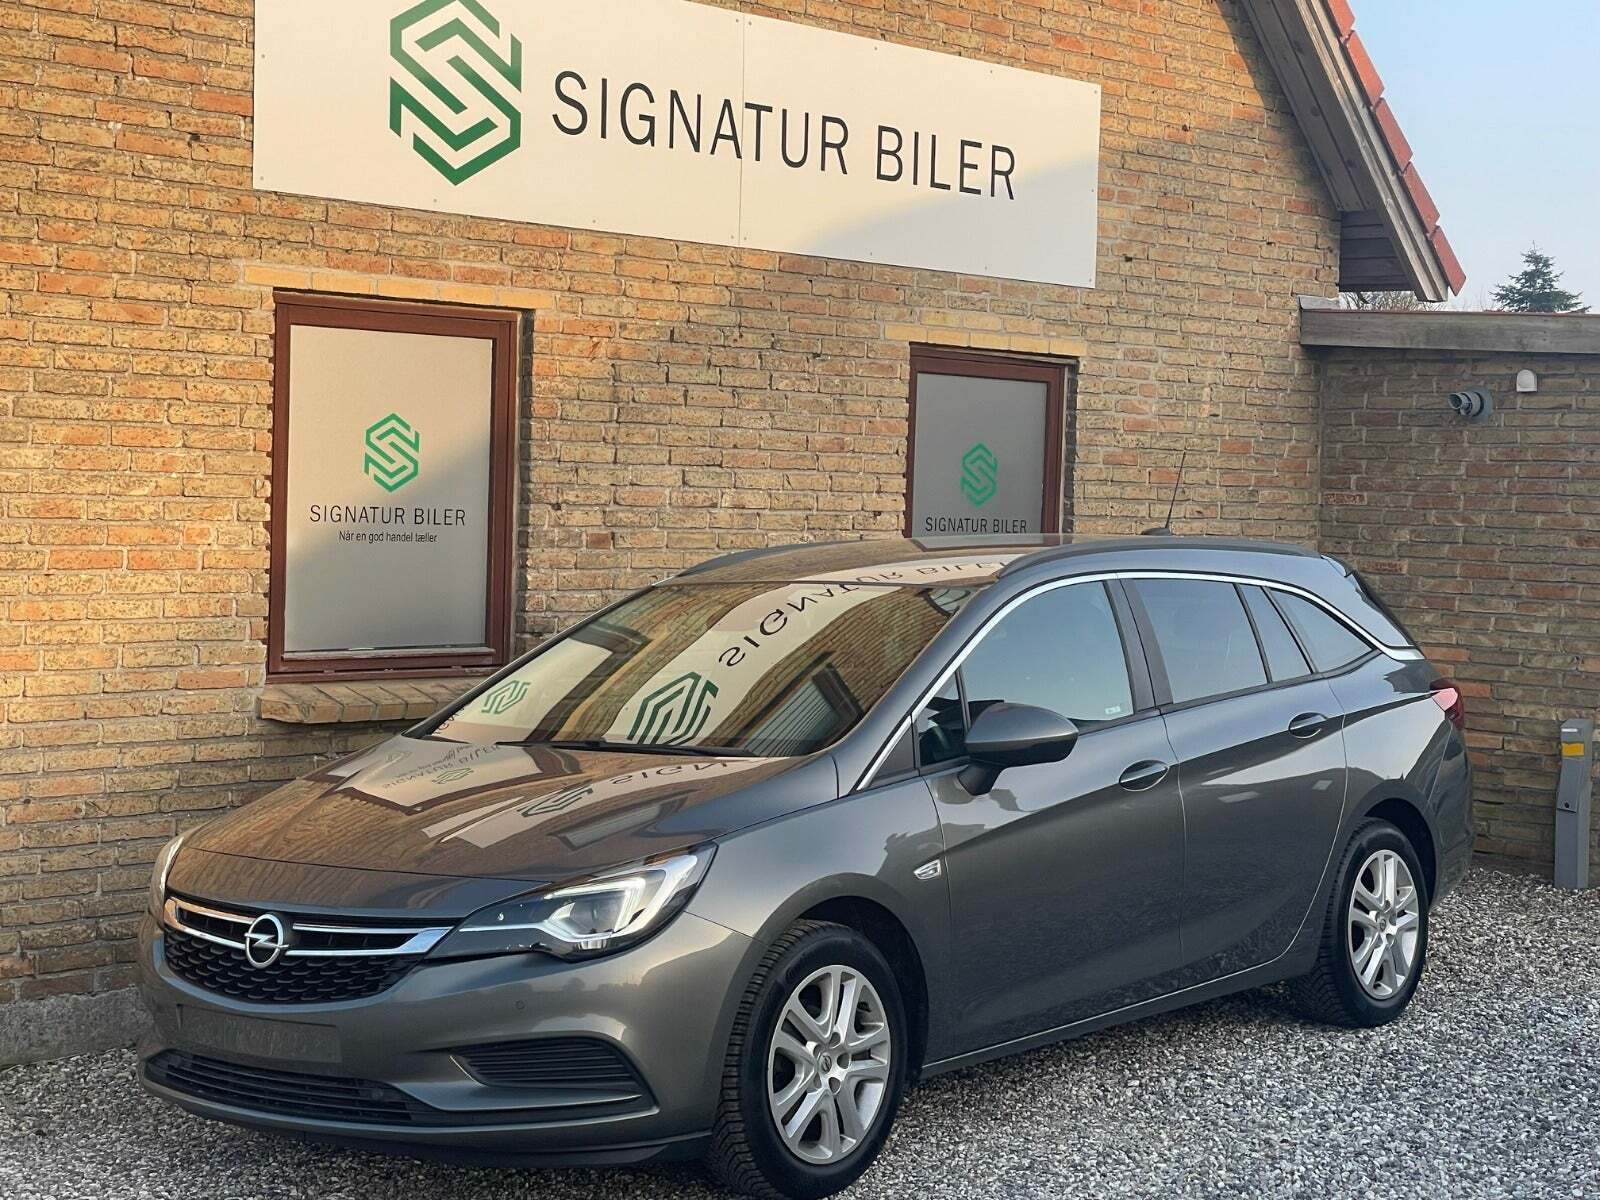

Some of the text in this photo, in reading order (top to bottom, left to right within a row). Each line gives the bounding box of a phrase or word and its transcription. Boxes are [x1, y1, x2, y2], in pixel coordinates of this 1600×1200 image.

[552, 69, 1017, 200] SIGNATUR BILER
[310, 505, 466, 526] SIGNATUR BILER
[925, 517, 1027, 534] SIGNATUR BILER
[338, 530, 354, 542] Når
[356, 533, 367, 541] en
[368, 532, 384, 544] god
[386, 532, 413, 543] handel
